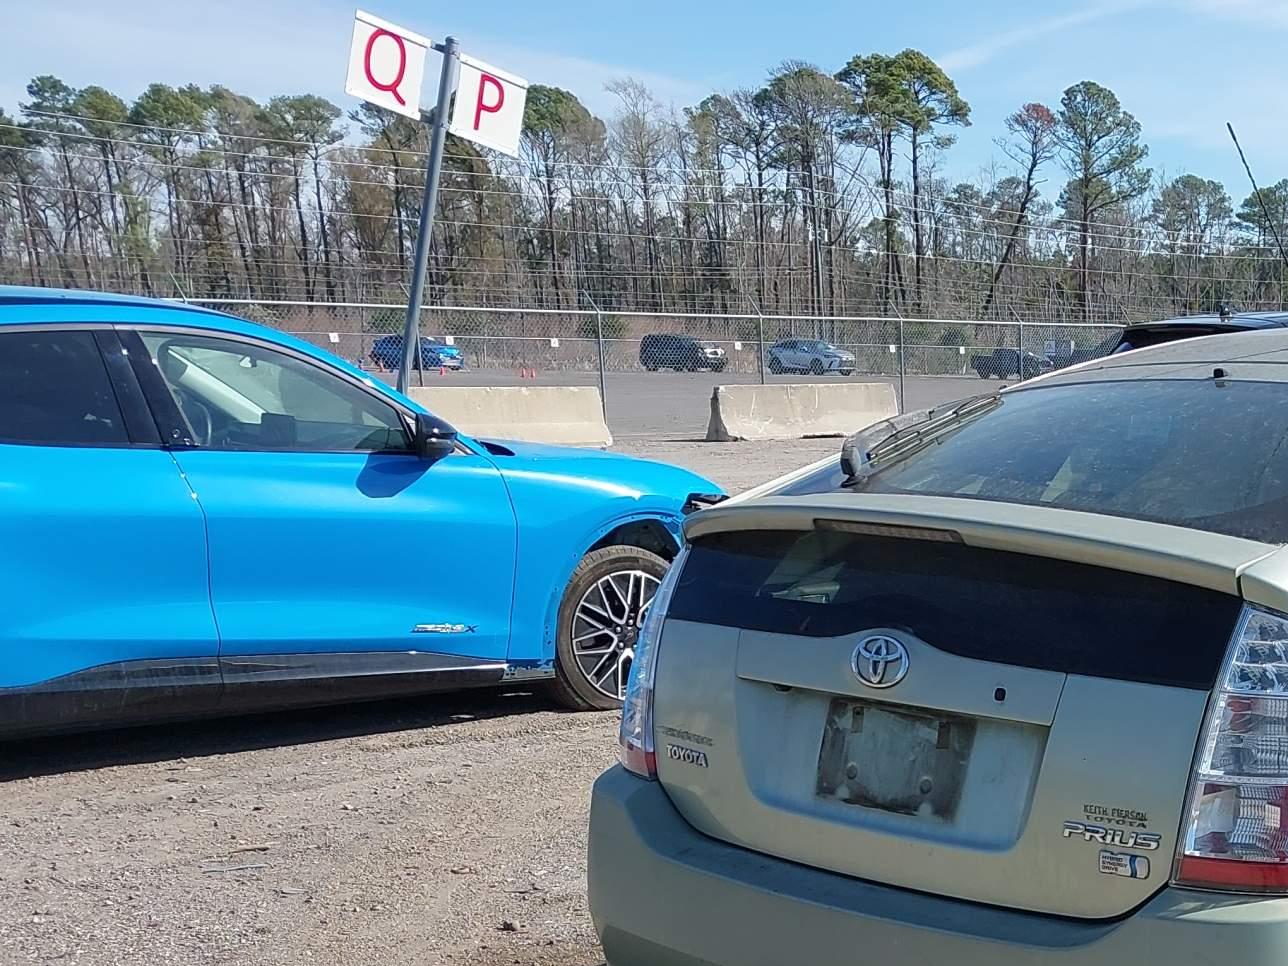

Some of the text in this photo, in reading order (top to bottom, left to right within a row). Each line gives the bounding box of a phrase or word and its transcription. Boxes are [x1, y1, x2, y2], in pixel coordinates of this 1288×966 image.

[364, 28, 405, 106] Q
[474, 73, 504, 130] P
[666, 743, 708, 768] TOYOTA
[1083, 803, 1108, 816] KEITH
[1085, 814, 1147, 828] TOYOTA
[1063, 820, 1162, 851] PRIUS
